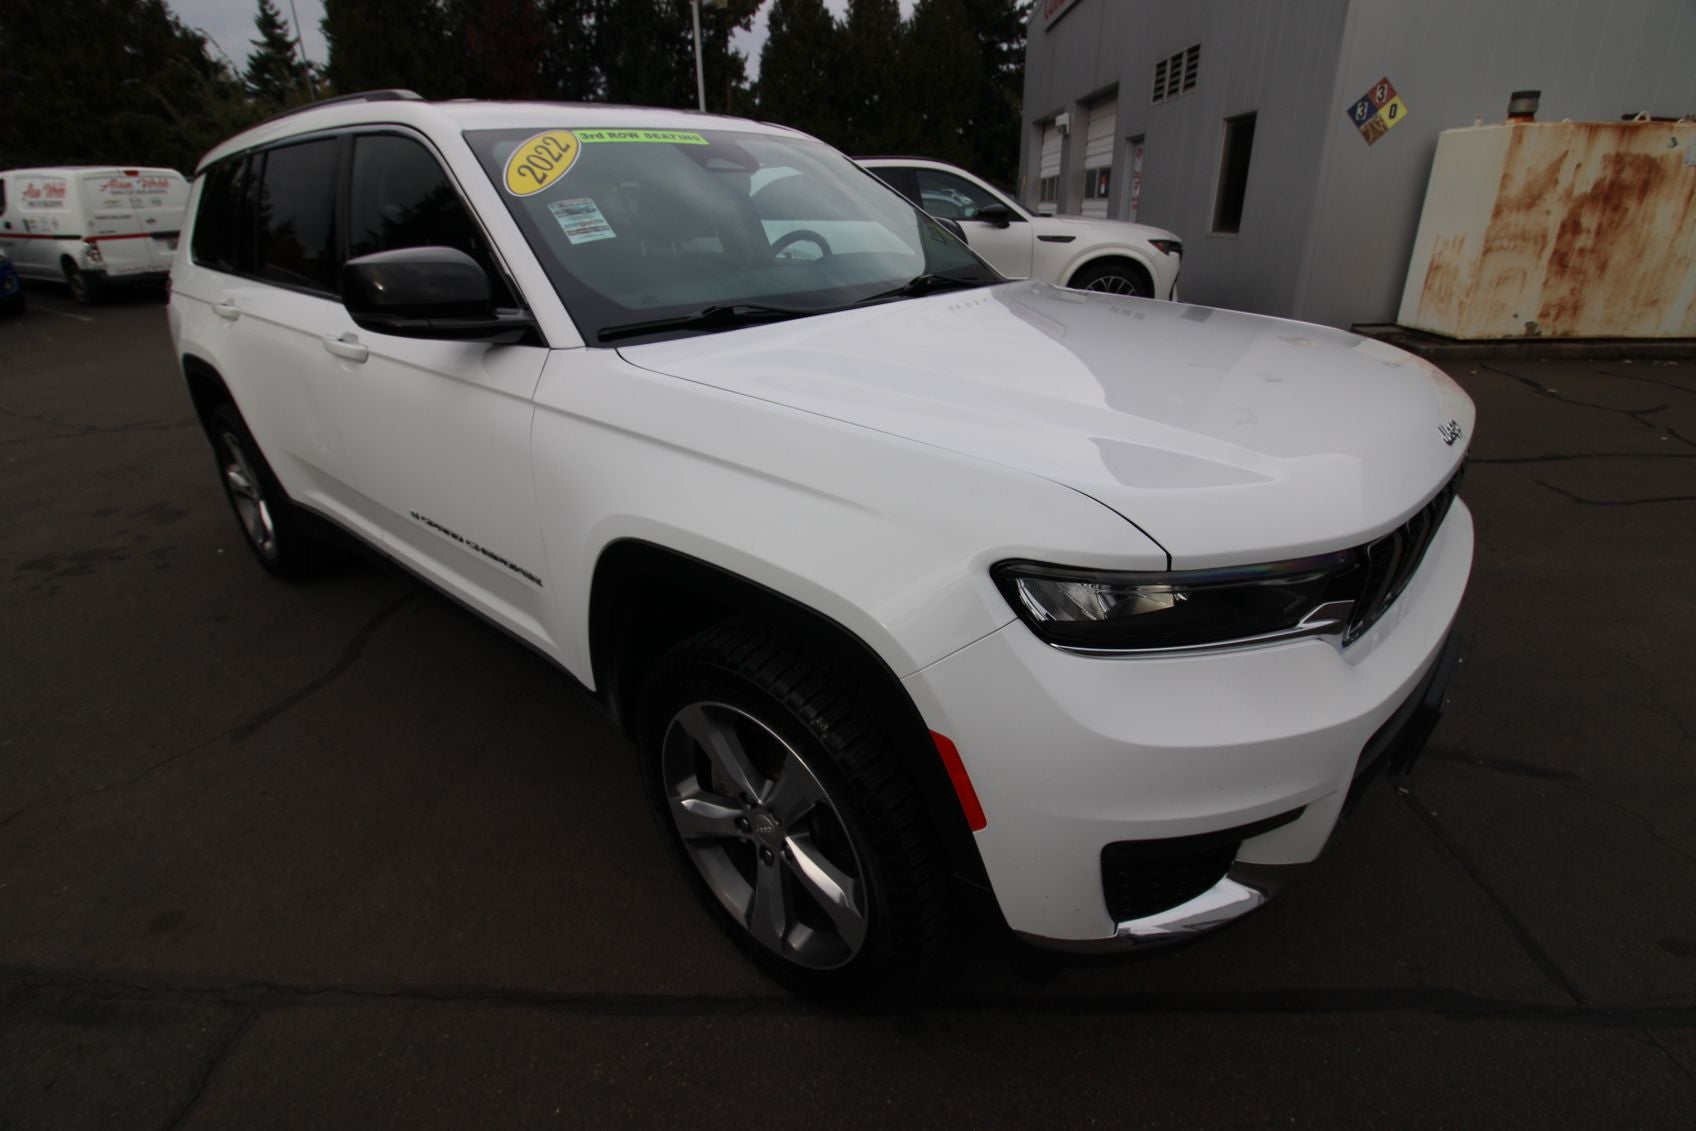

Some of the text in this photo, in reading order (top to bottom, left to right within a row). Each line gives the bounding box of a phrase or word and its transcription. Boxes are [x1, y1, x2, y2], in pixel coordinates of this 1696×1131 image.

[1377, 85, 1386, 102] 3
[1358, 102, 1398, 119] 3 0
[581, 132, 605, 140] 3rd
[643, 132, 701, 141] SEATING
[517, 136, 571, 185] 2022
